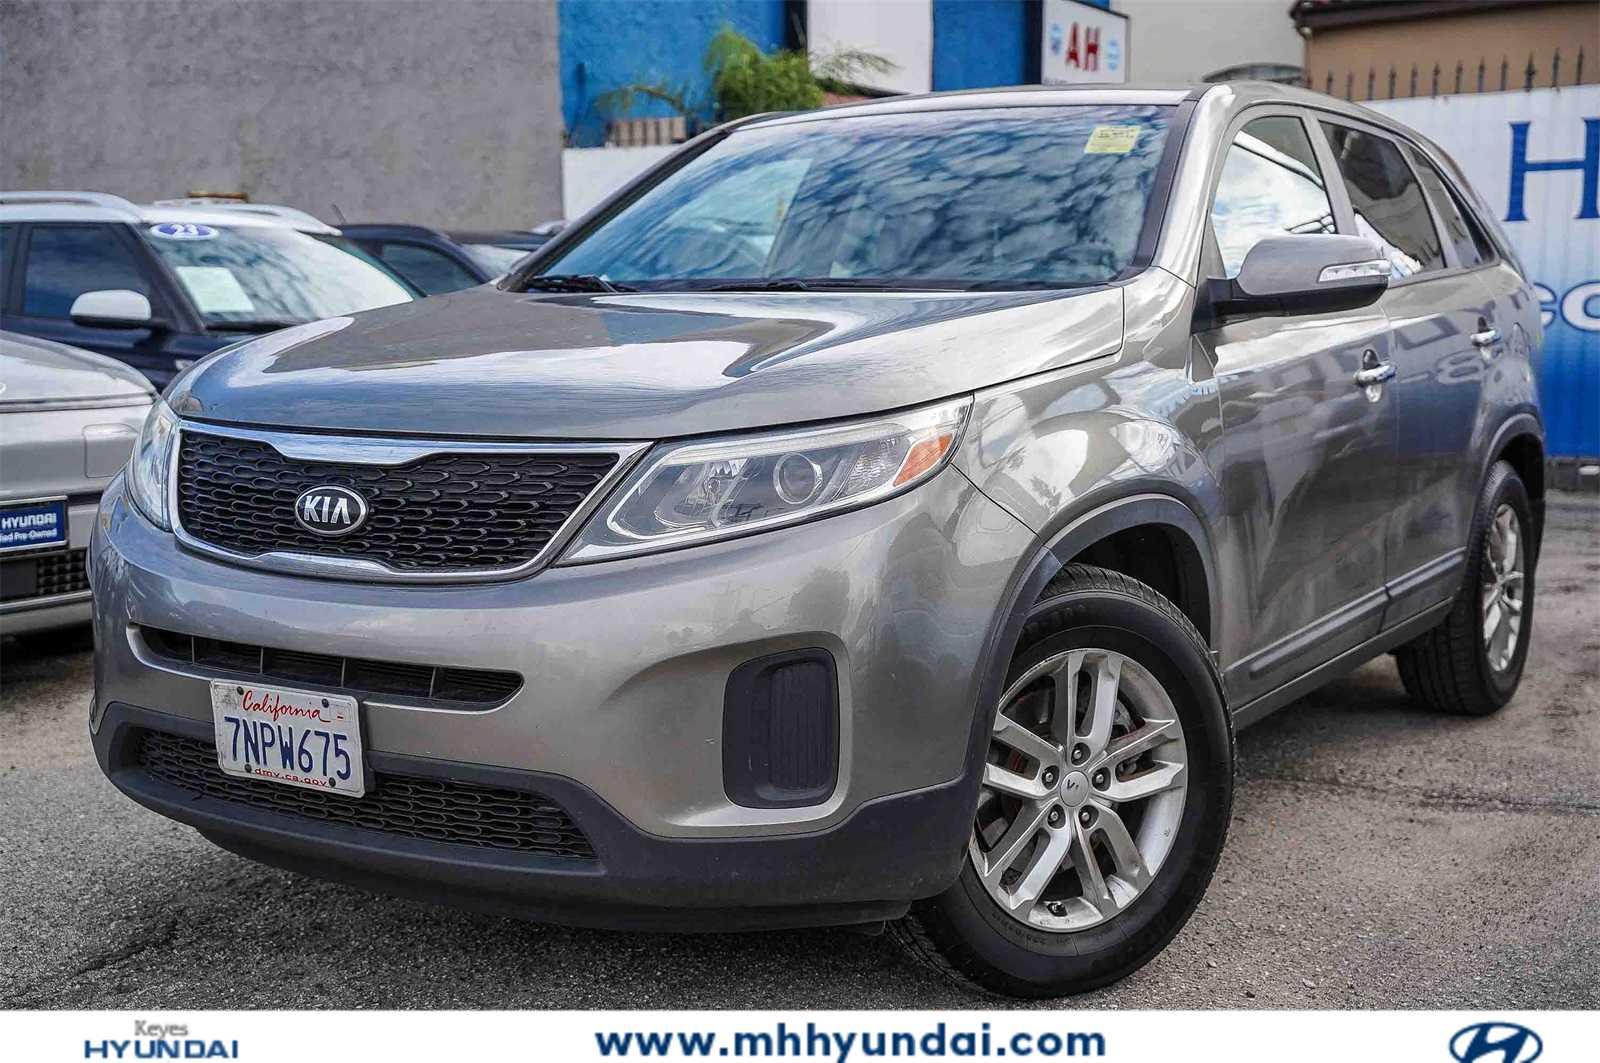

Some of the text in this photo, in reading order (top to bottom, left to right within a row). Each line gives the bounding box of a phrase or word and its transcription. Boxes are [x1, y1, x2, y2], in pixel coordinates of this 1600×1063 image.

[1, 512, 57, 529] HYUNDAI
[303, 495, 351, 524] KIA
[242, 690, 331, 722] California
[224, 716, 351, 781] 7NPW675
[254, 767, 329, 788] dmv.ca.gov
